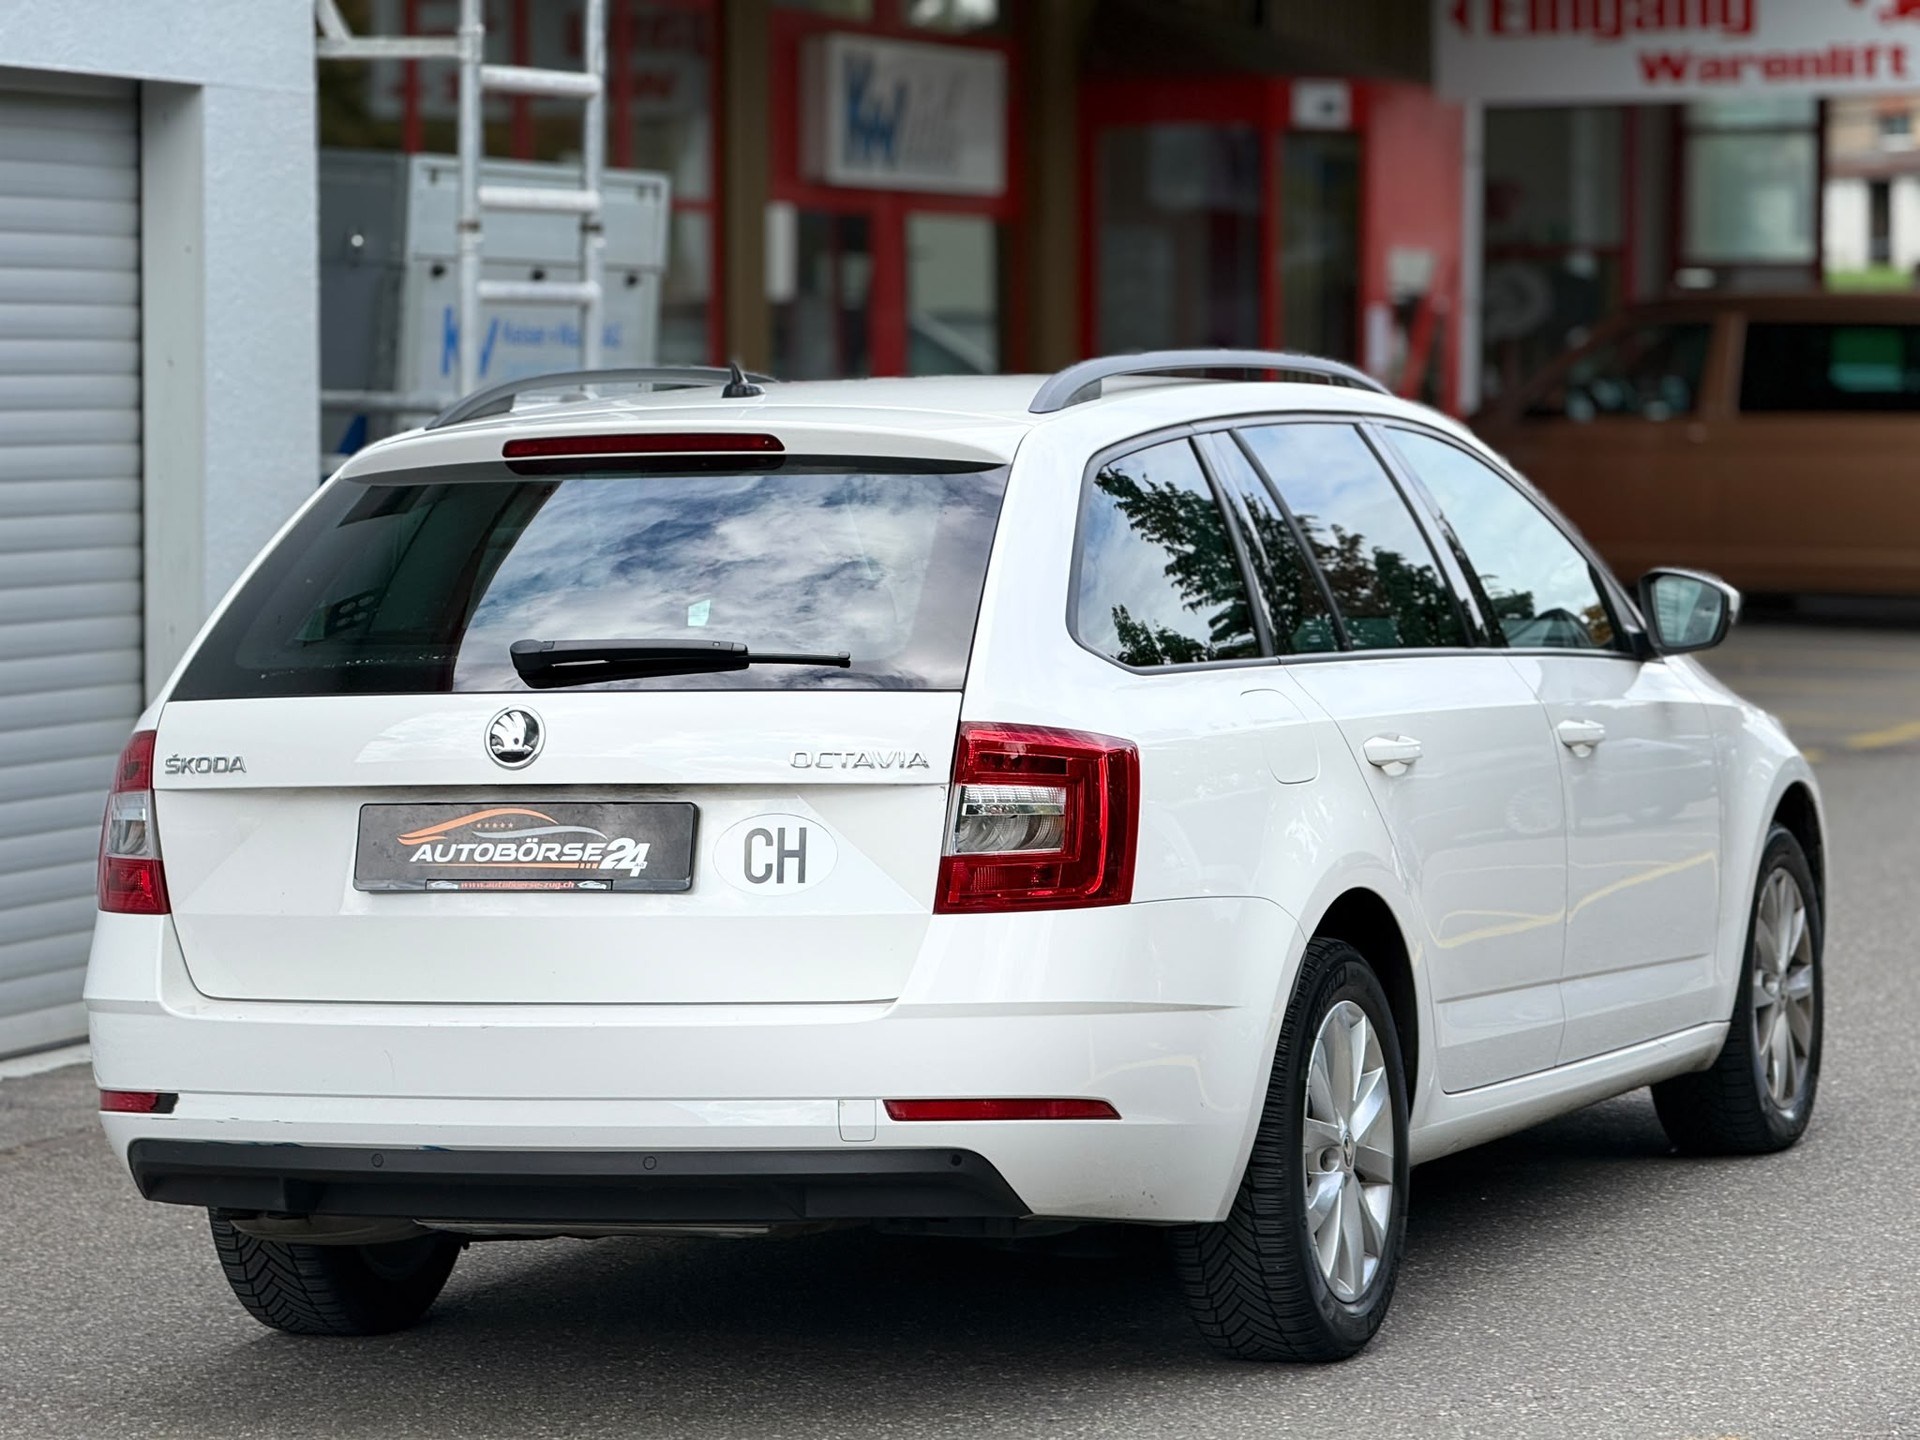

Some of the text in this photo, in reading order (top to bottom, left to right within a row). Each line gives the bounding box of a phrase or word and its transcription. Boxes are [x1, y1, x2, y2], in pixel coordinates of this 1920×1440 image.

[164, 753, 248, 775] ŠKODA
[789, 750, 931, 770] OCTAVIA
[743, 826, 807, 884] CH
